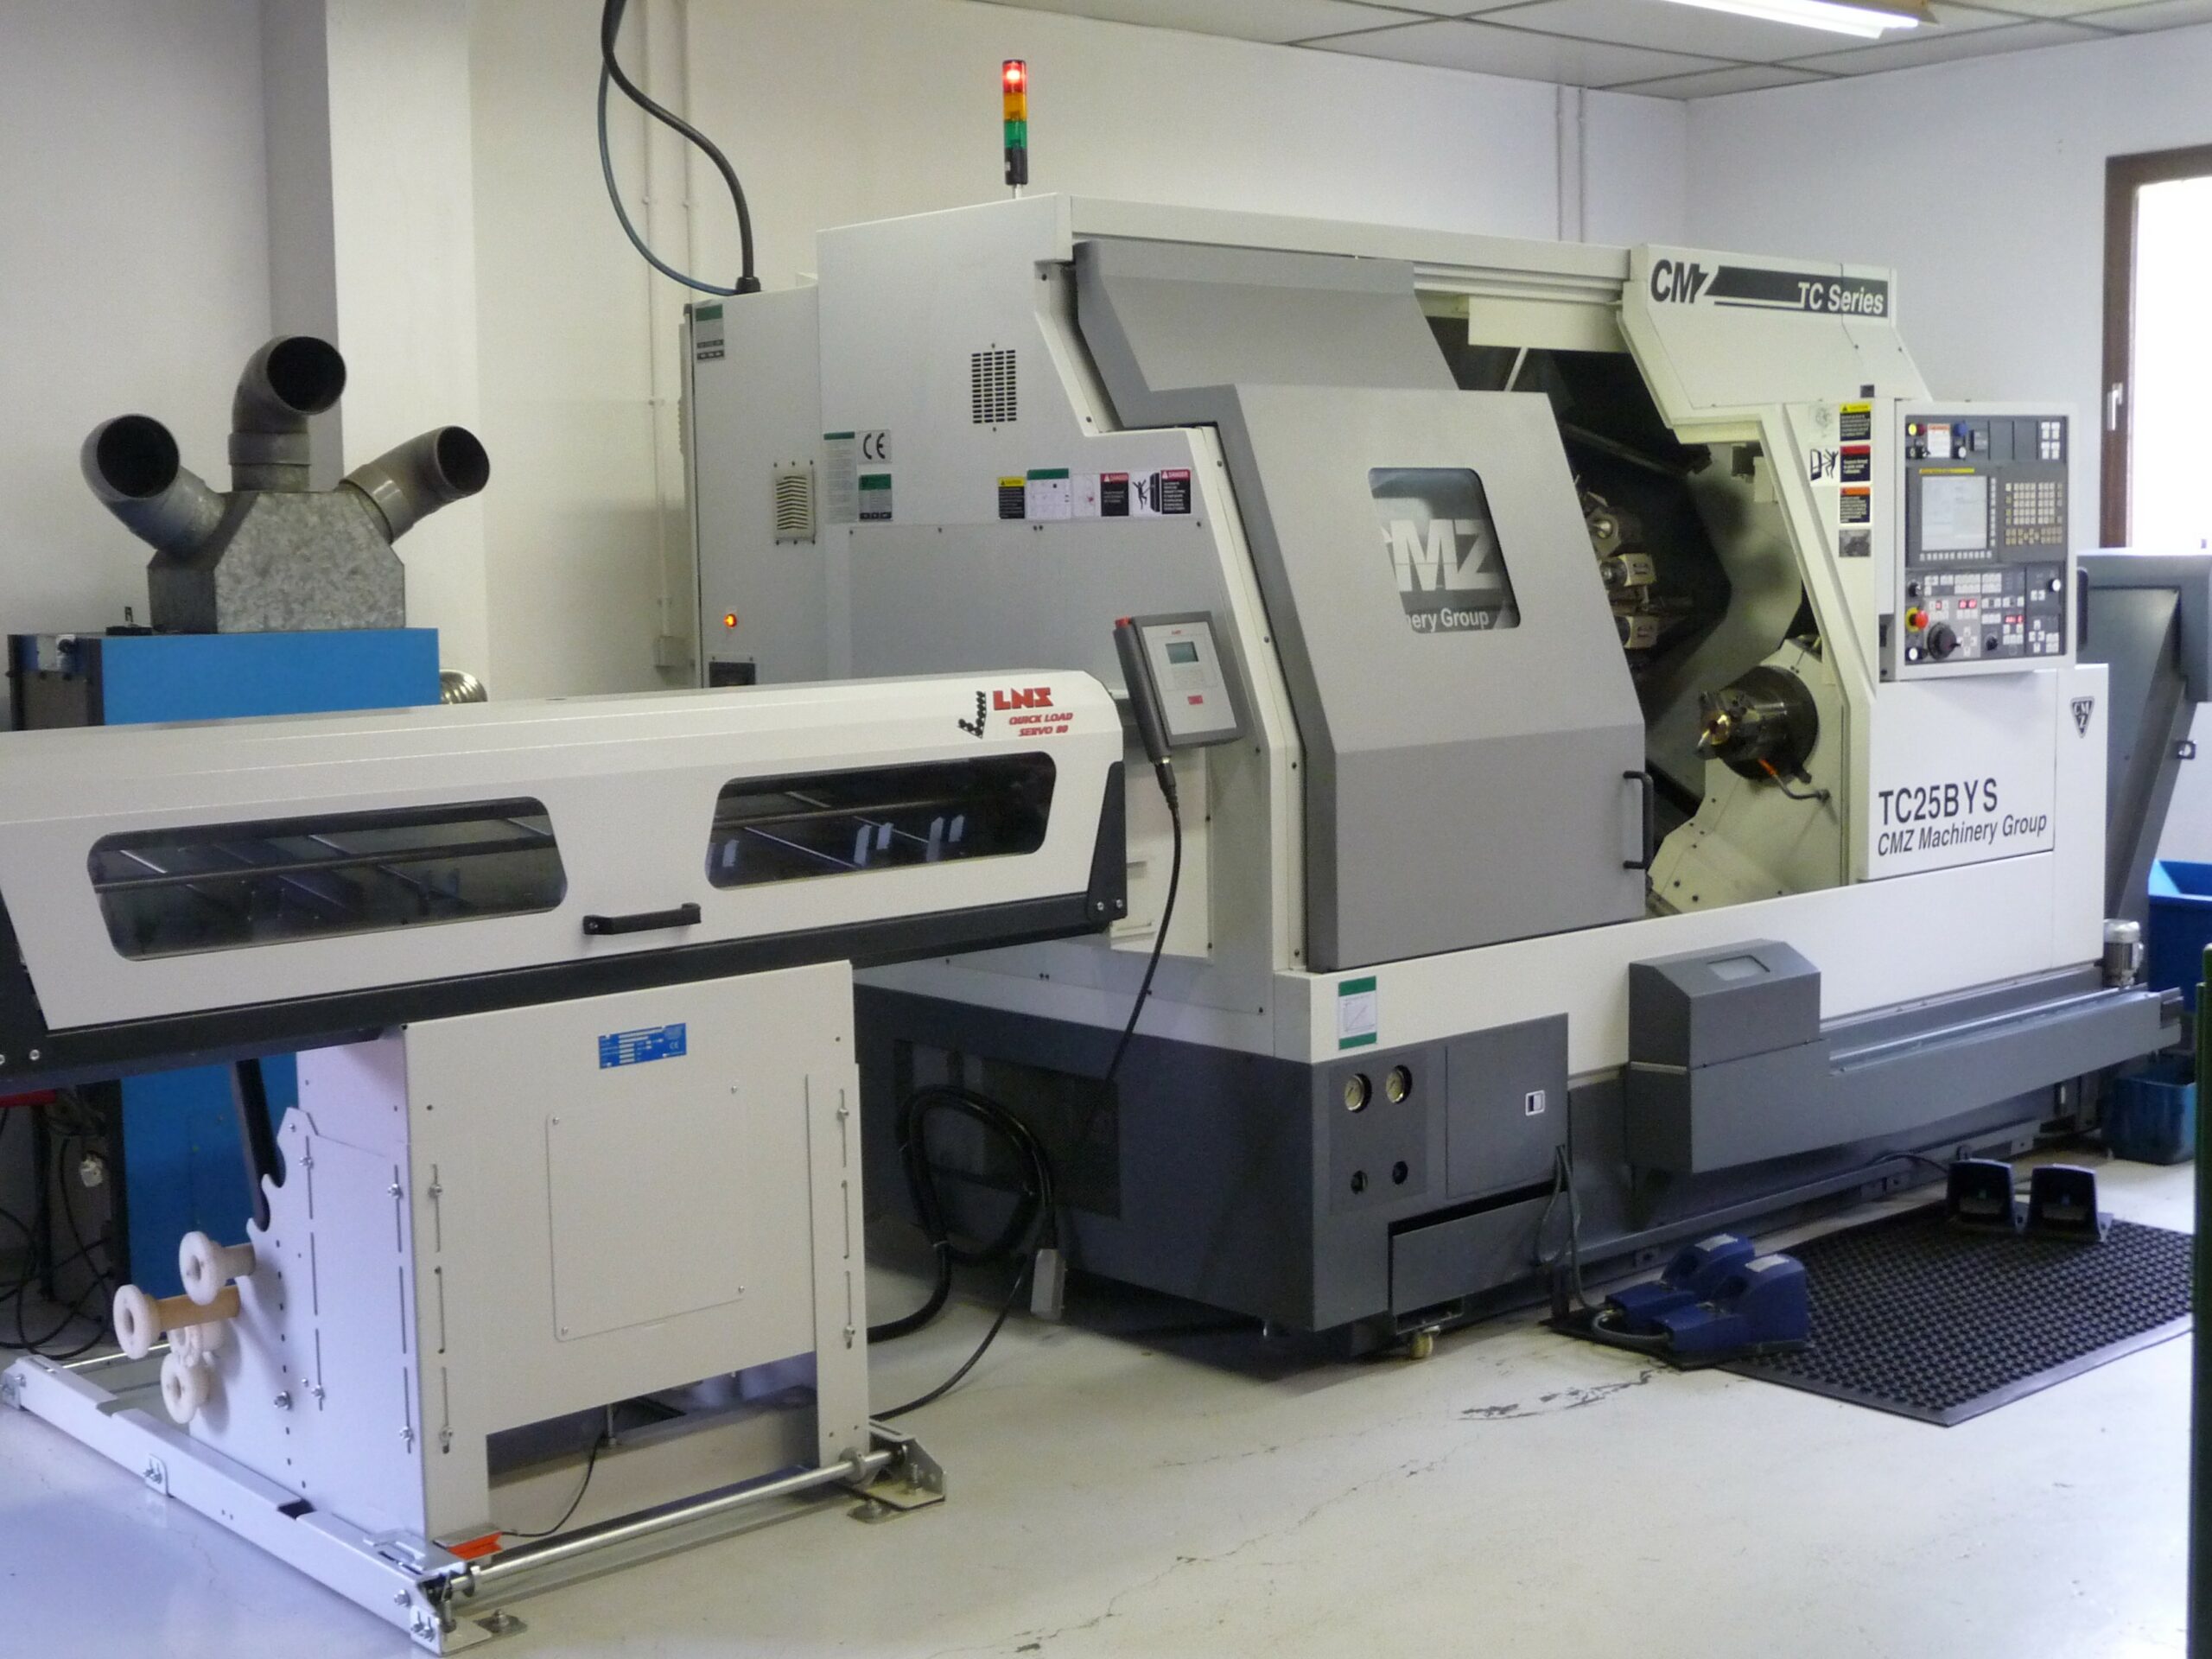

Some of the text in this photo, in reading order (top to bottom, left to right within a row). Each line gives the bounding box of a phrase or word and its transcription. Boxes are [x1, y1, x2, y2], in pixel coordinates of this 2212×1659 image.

[1798, 281, 1823, 309] TC
[1827, 284, 1884, 315] Series
[1440, 607, 1490, 627] Group
[1009, 712, 1073, 725] QUICK LOAD
[1018, 726, 1053, 737] SERVO
[1878, 814, 2047, 856] CMZ Machinery Group
